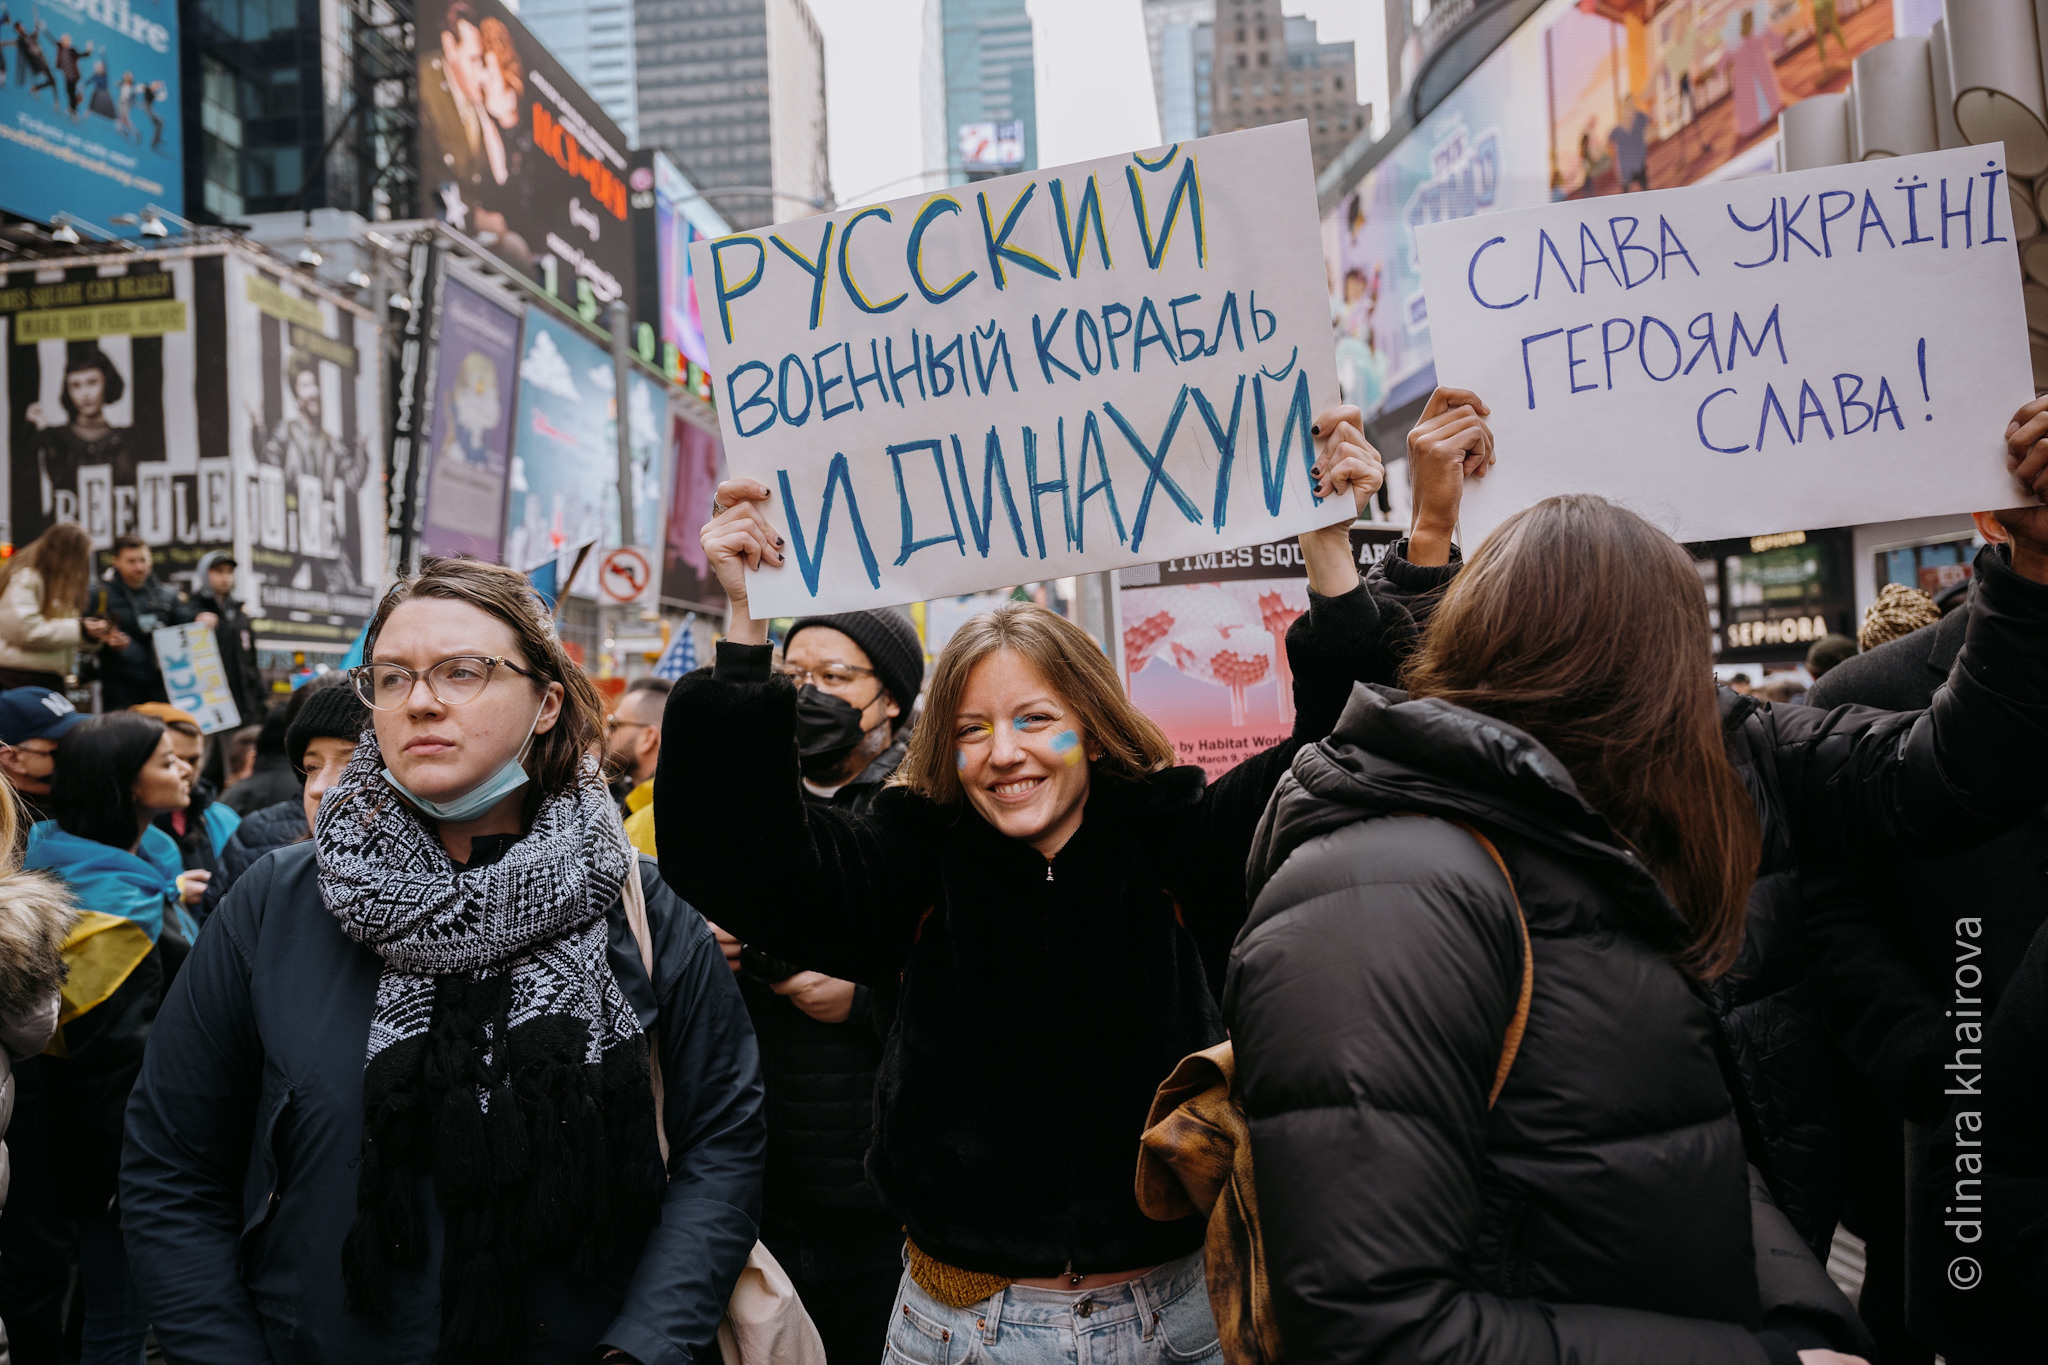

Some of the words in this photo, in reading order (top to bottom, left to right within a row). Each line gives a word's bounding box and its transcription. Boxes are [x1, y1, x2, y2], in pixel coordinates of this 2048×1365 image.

[709, 142, 1208, 344] РУССКИЙ
[1468, 214, 1700, 310] СЛАВА
[1727, 160, 2008, 269] УКРАЇНІ
[726, 318, 1018, 438] ВОЕННЫЙ
[1032, 289, 1277, 385] КОРАБЛЬ
[1521, 303, 1788, 410] ГЕРОЯМ
[1696, 337, 1933, 454] СЛАВА!
[1727, 615, 1828, 648] SEPHORA
[1180, 741, 1194, 753] by
[1199, 737, 1248, 751] Habitat
[1197, 753, 1228, 764] March
